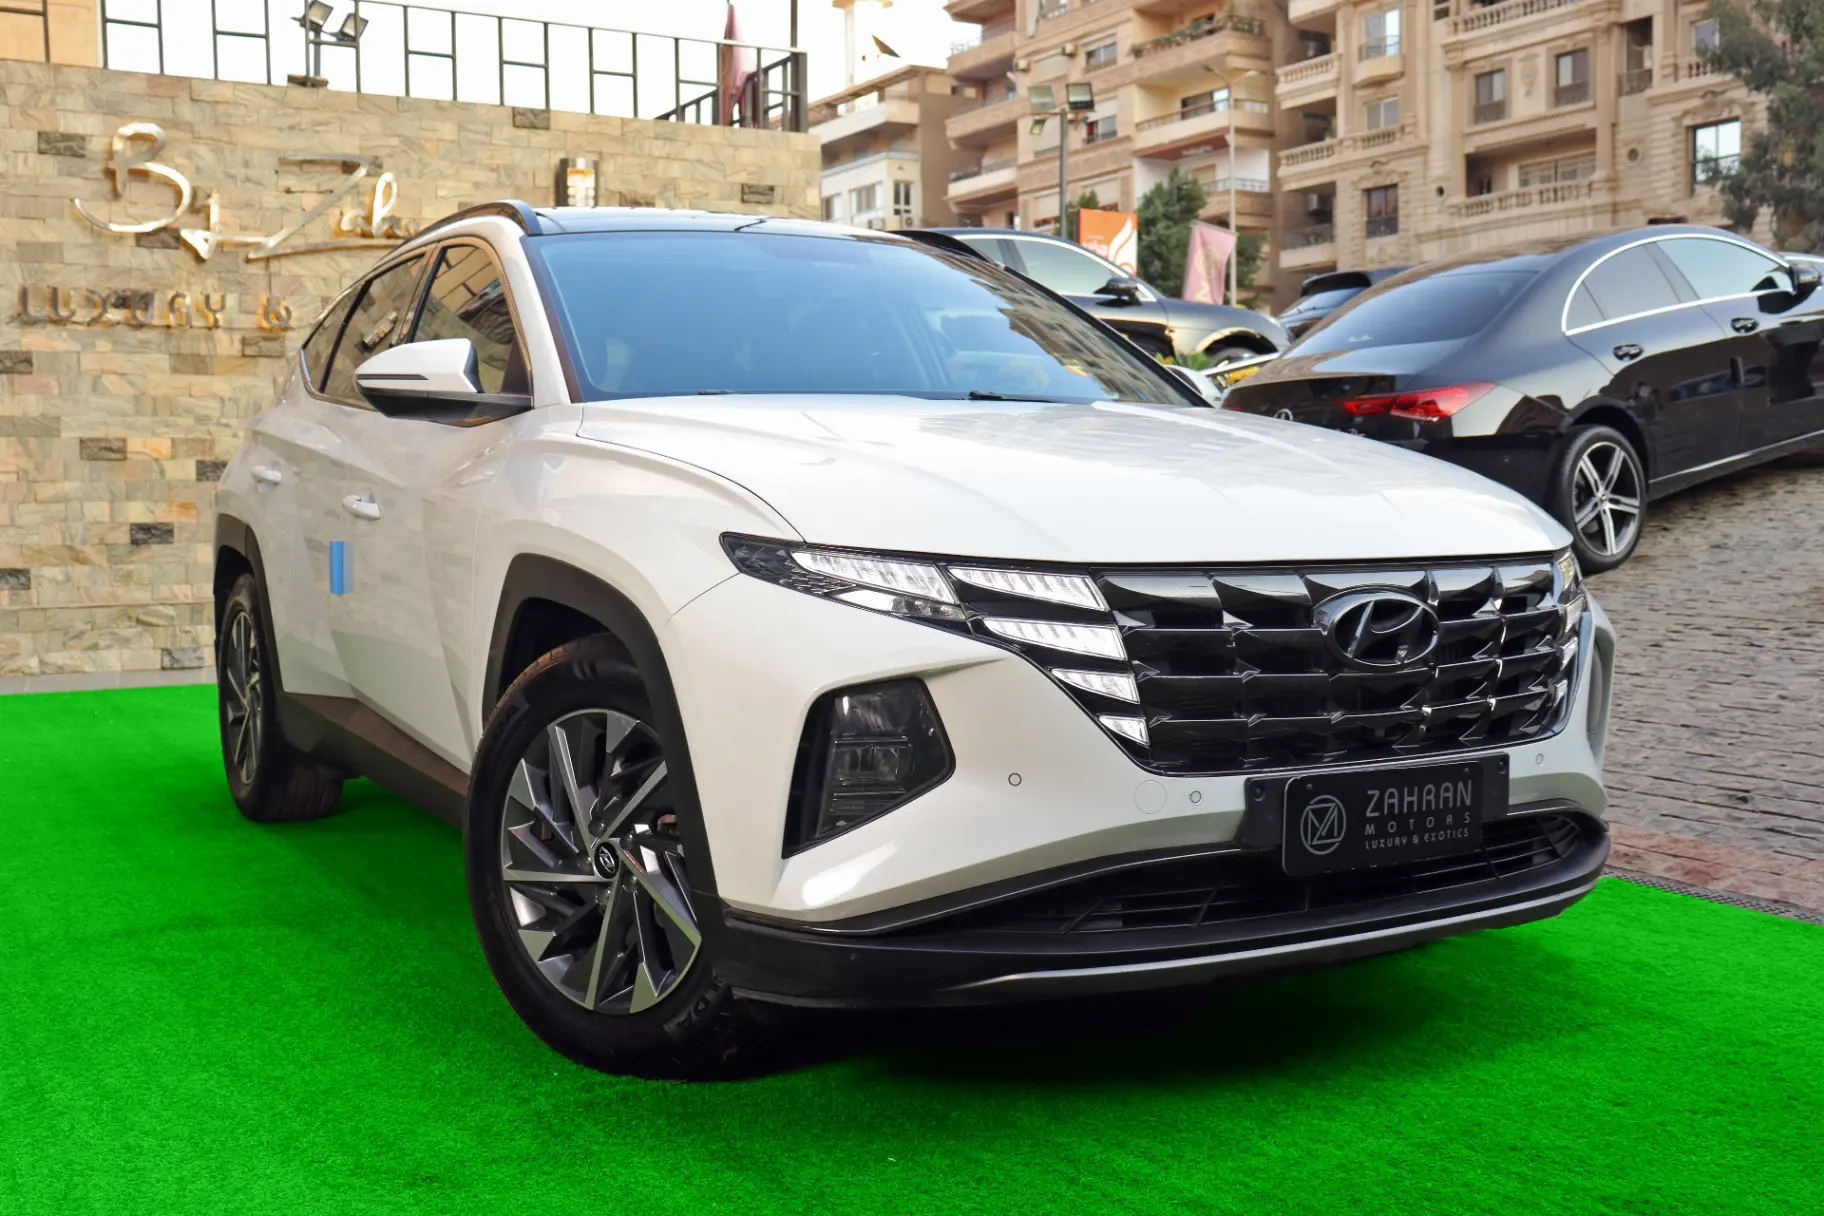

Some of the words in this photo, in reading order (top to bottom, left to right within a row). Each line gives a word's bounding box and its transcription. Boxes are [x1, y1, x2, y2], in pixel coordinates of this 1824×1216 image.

[263, 295, 292, 329] &
[1365, 780, 1472, 818] ZAHRAN
[1365, 811, 1470, 836] MOTORS
[1365, 836, 1408, 850] LUXURY
[1412, 834, 1420, 844] &
[1424, 827, 1470, 843] EXOTICS
